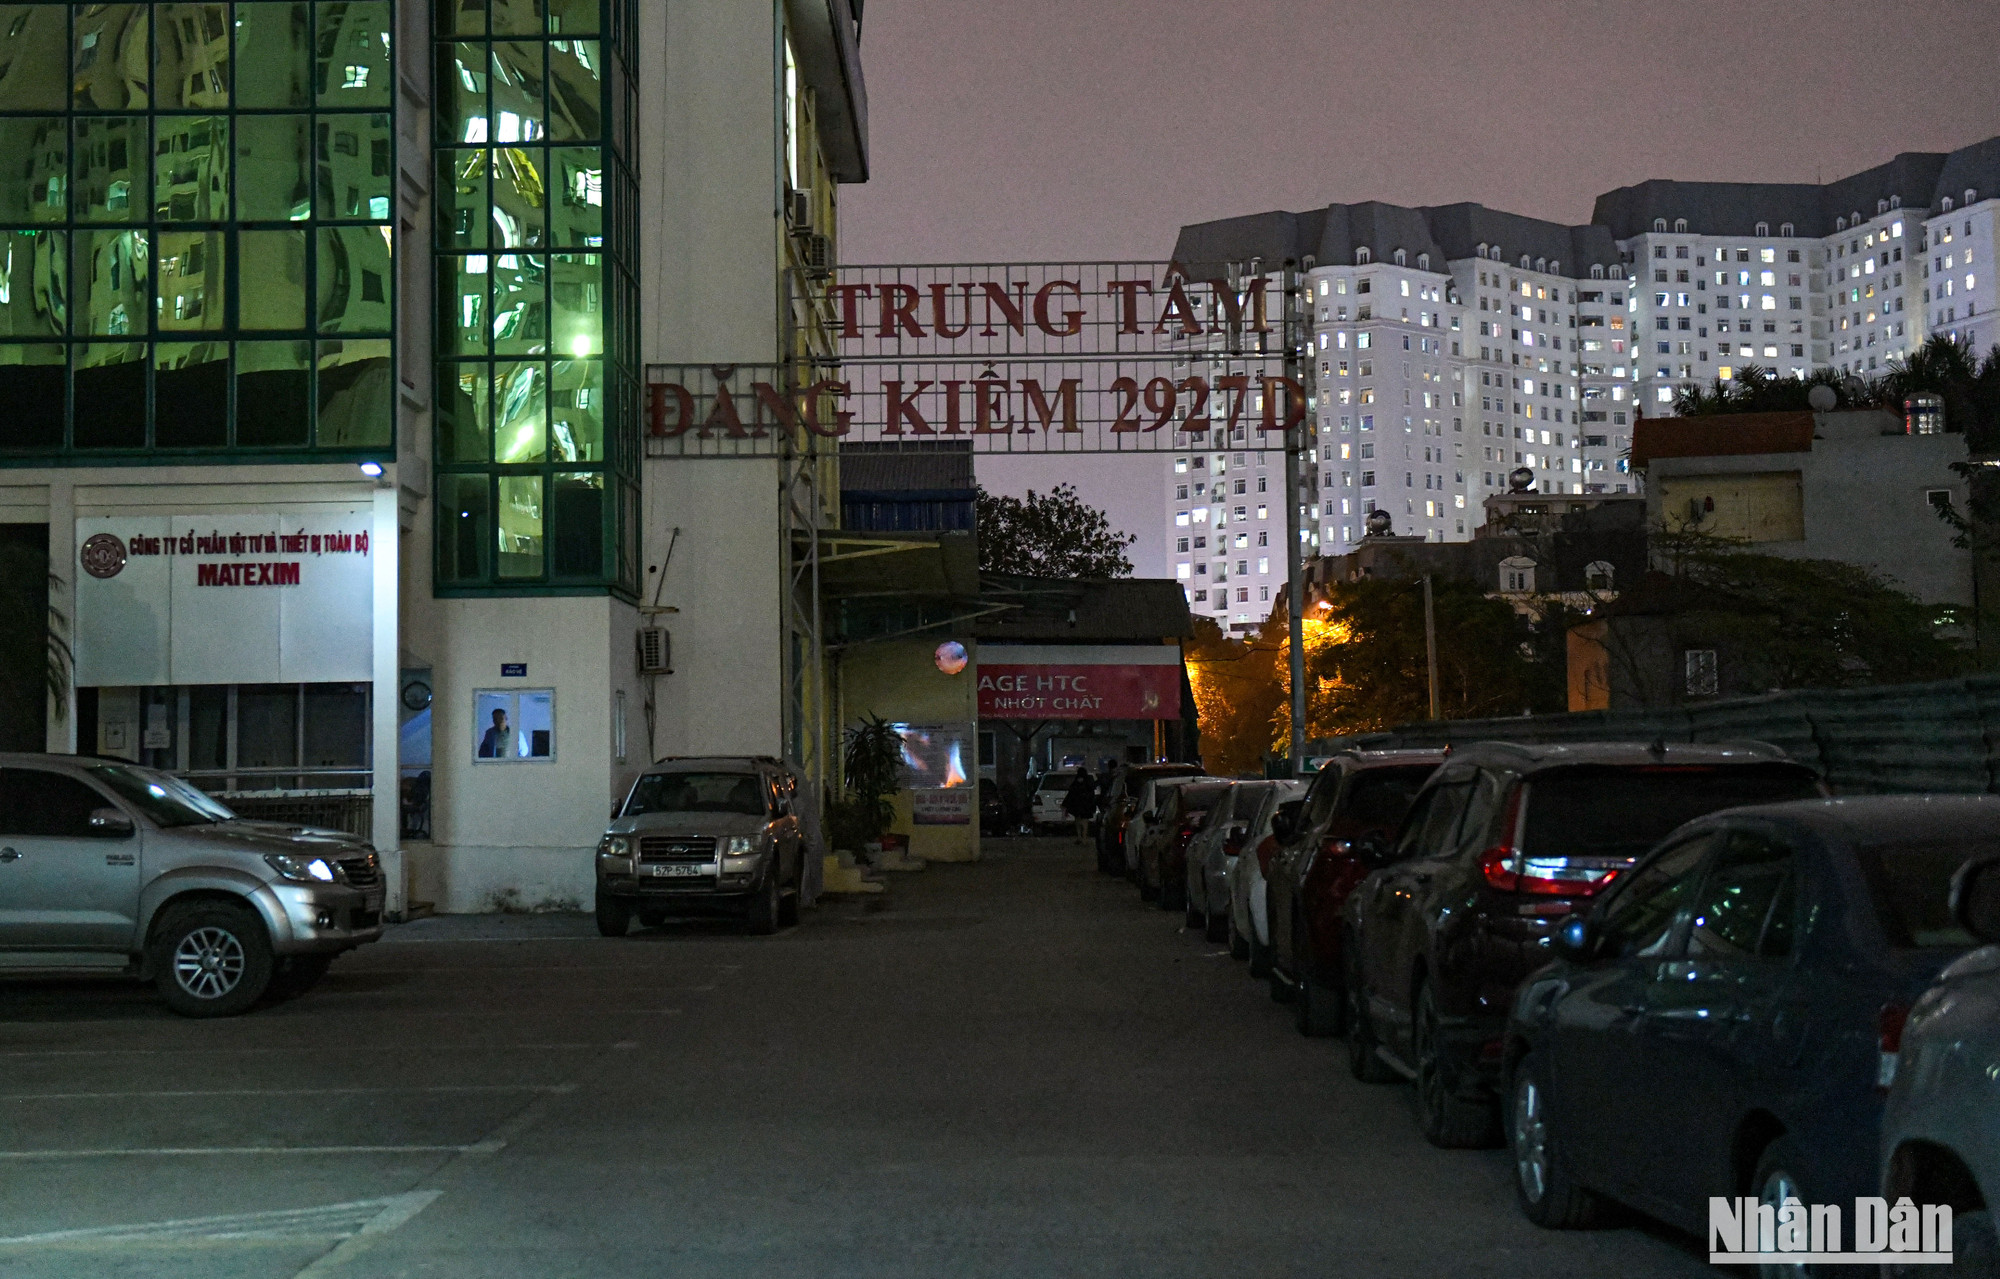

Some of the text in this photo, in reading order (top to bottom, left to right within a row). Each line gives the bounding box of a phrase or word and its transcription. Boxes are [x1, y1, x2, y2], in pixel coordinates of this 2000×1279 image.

[826, 261, 1273, 338] TRUNG TÂM
[646, 364, 855, 438] ĐĂNG
[1110, 376, 1305, 432] 2927D
[130, 533, 160, 555] CÔNG
[163, 537, 177, 555] TY
[180, 529, 194, 554] CỔ
[248, 533, 262, 554] TƯ
[264, 531, 277, 554] VÀ
[280, 528, 308, 553] THIẾT
[311, 535, 321, 556] BỊ
[324, 530, 351, 553] TOÀN
[355, 530, 368, 557] BỘ
[198, 563, 299, 586] MATEXIM
[1036, 675, 1087, 692] HTC
[994, 694, 1047, 709] NHỚT
[1053, 694, 1103, 709] CHẤT
